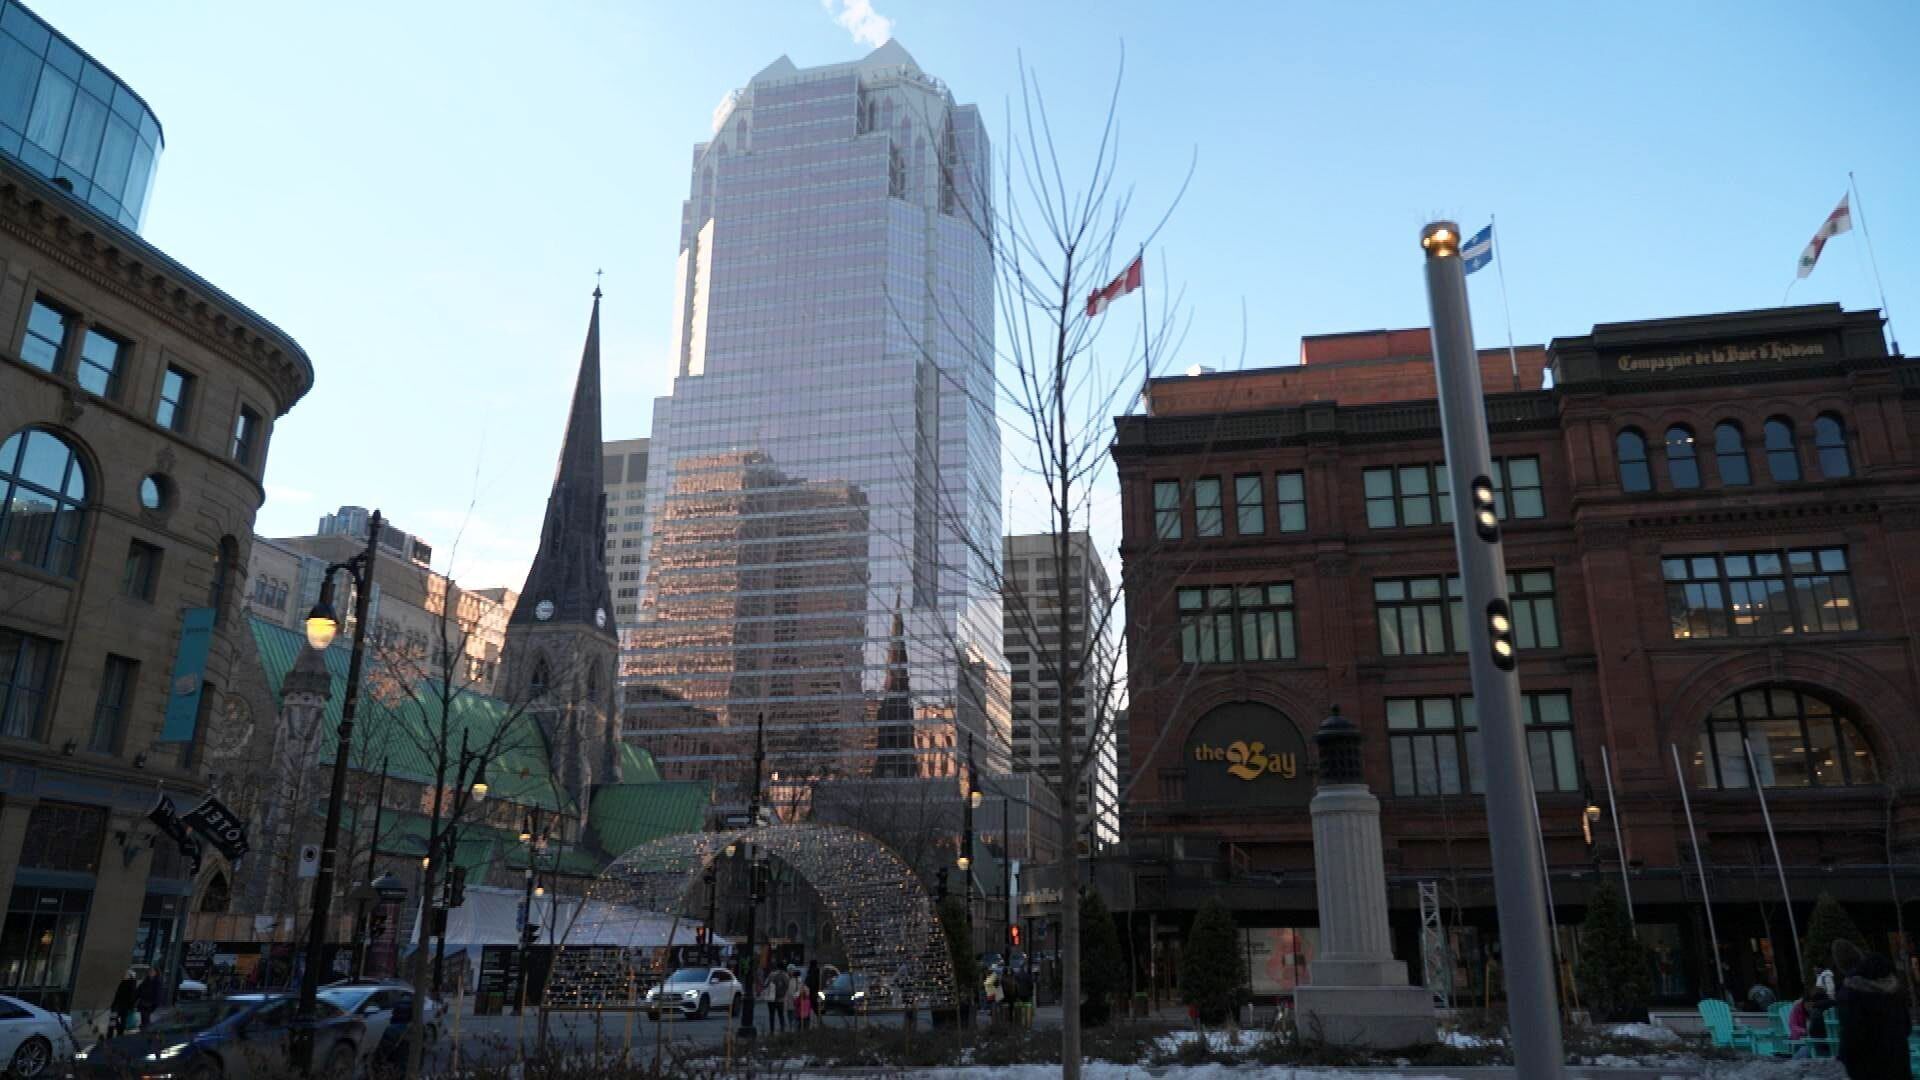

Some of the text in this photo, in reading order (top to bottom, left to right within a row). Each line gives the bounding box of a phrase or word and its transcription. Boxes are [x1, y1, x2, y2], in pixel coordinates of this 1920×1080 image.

[1618, 354, 1692, 372] Compagnie
[1695, 350, 1711, 365] de
[1712, 348, 1725, 363] la
[1194, 740, 1297, 780] the Bay
